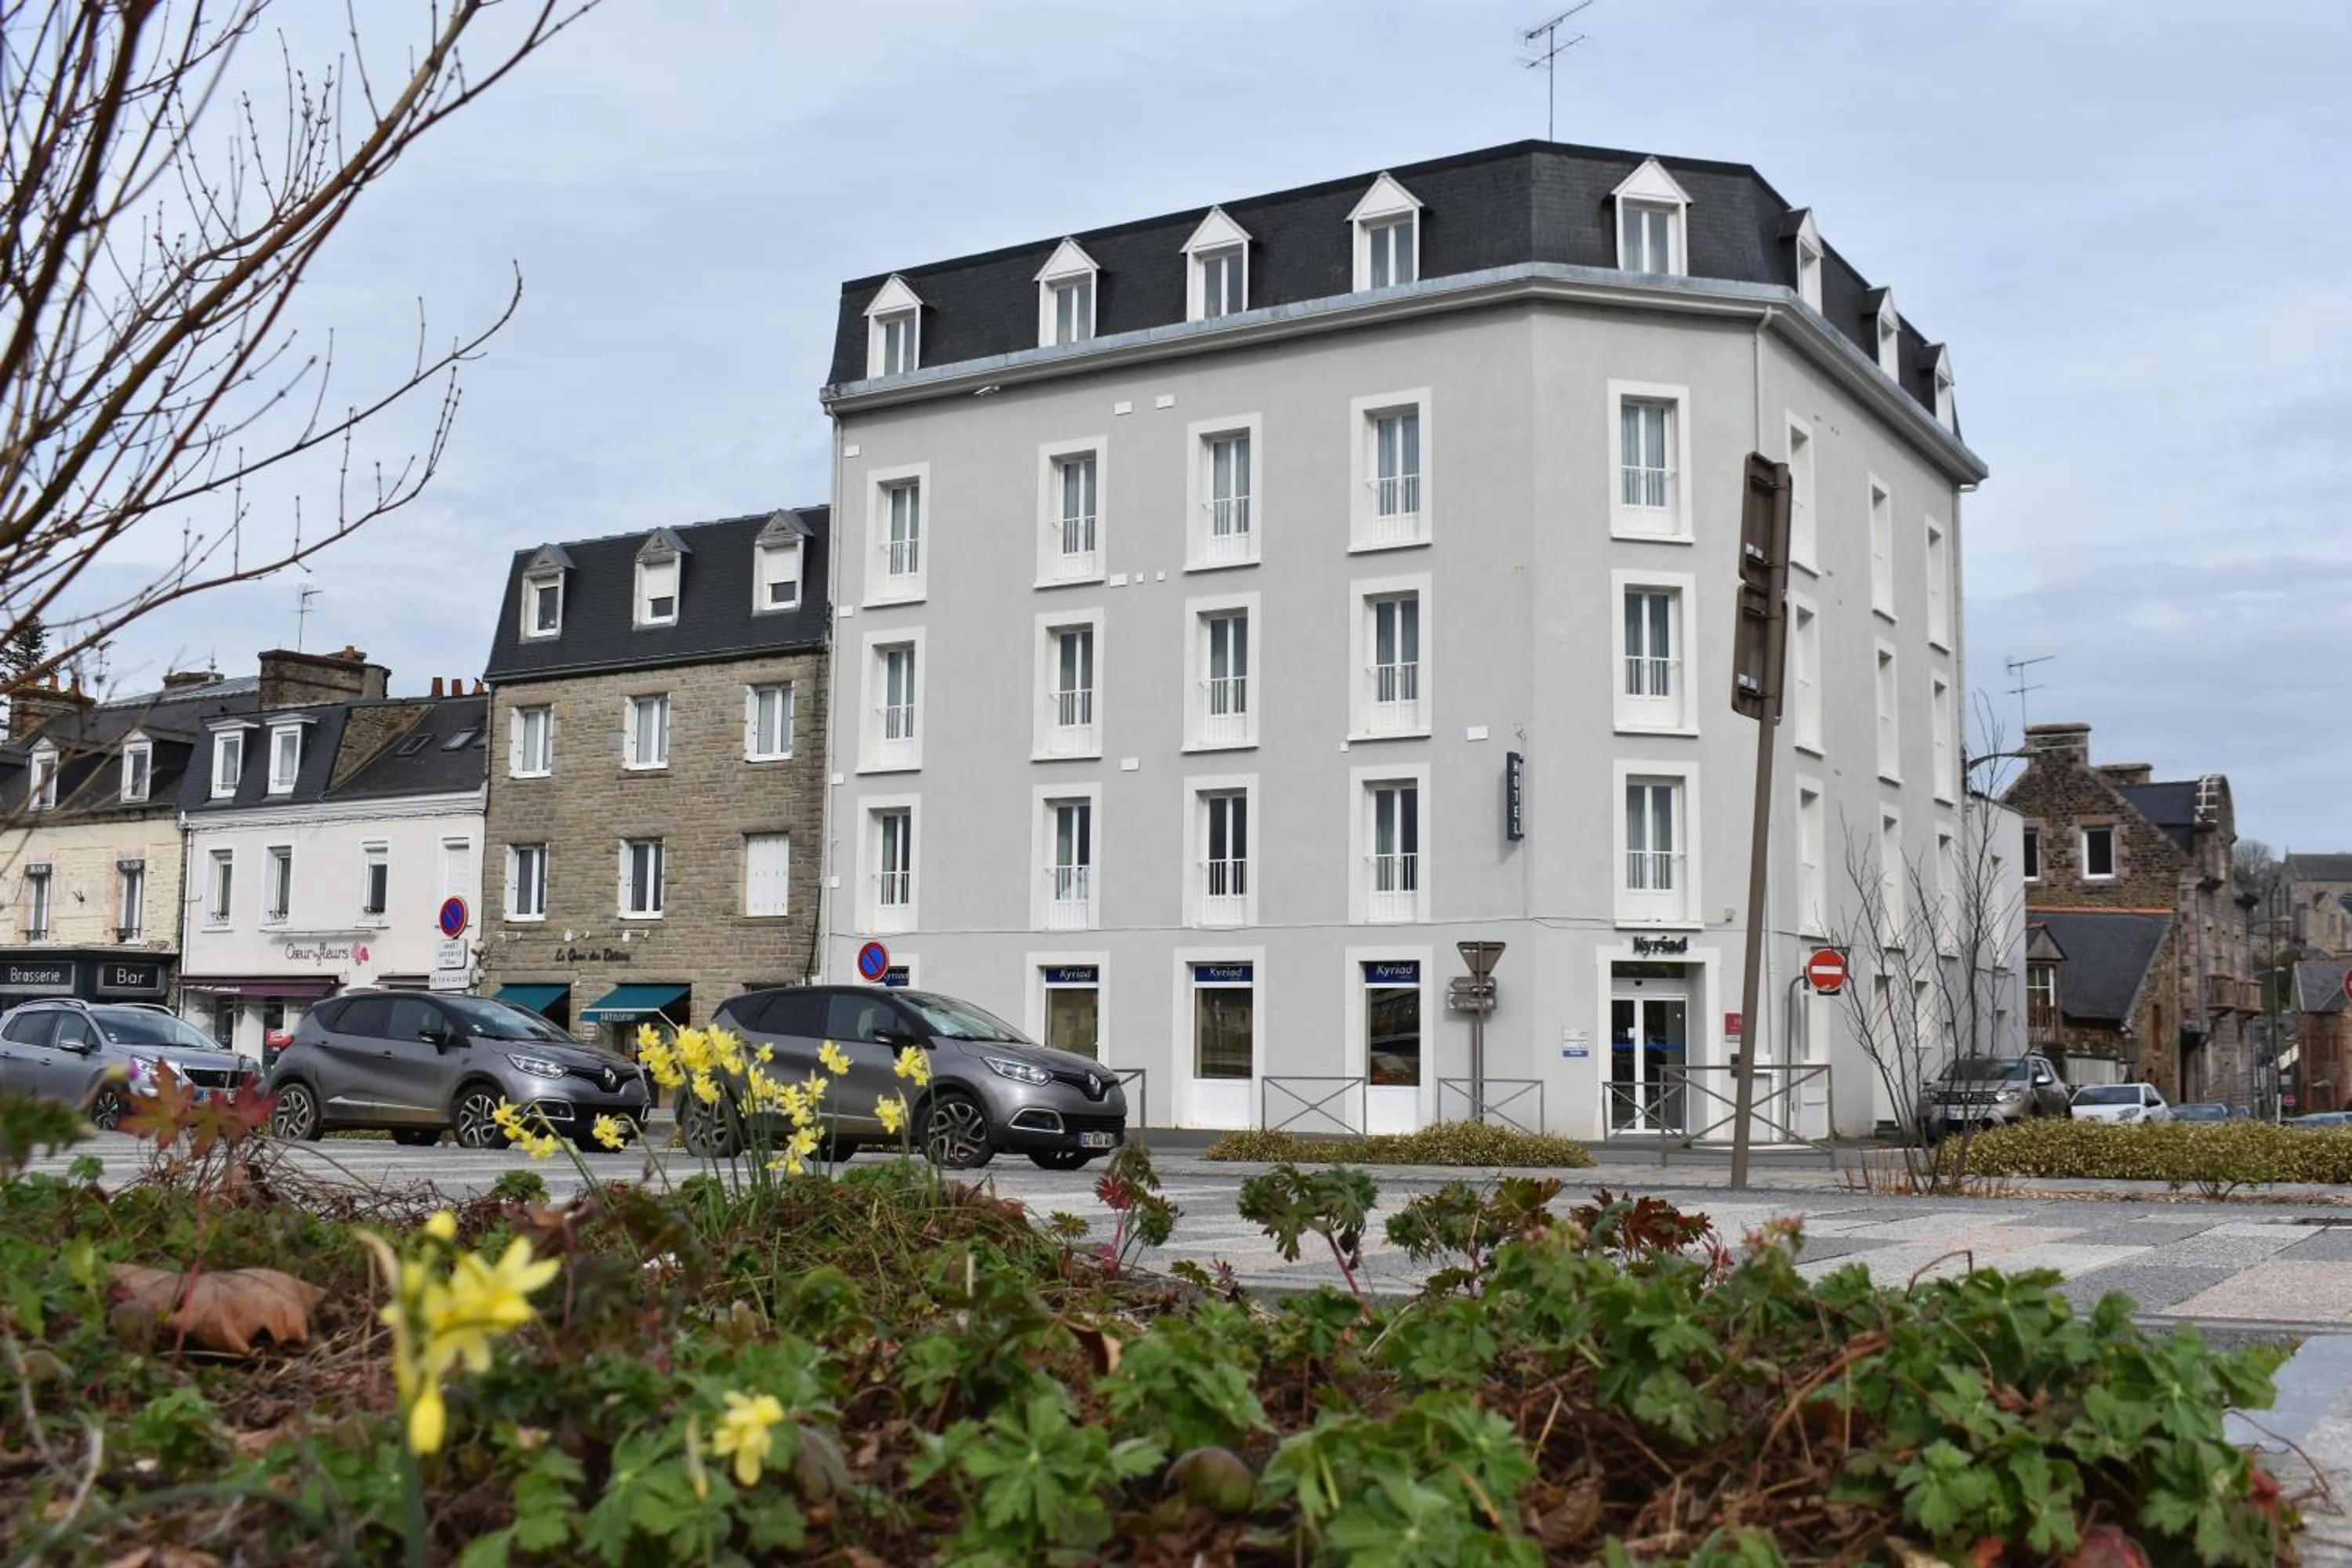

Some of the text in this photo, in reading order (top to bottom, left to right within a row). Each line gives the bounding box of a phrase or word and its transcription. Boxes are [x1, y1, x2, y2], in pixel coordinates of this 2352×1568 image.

[1633, 935, 1688, 958] Kyriad
[10, 967, 60, 982] Brasserie
[117, 968, 145, 984] Bar
[1059, 968, 1092, 980] Kyriad
[1209, 965, 1243, 978] Kyriad
[1377, 964, 1414, 978] Kyriad
